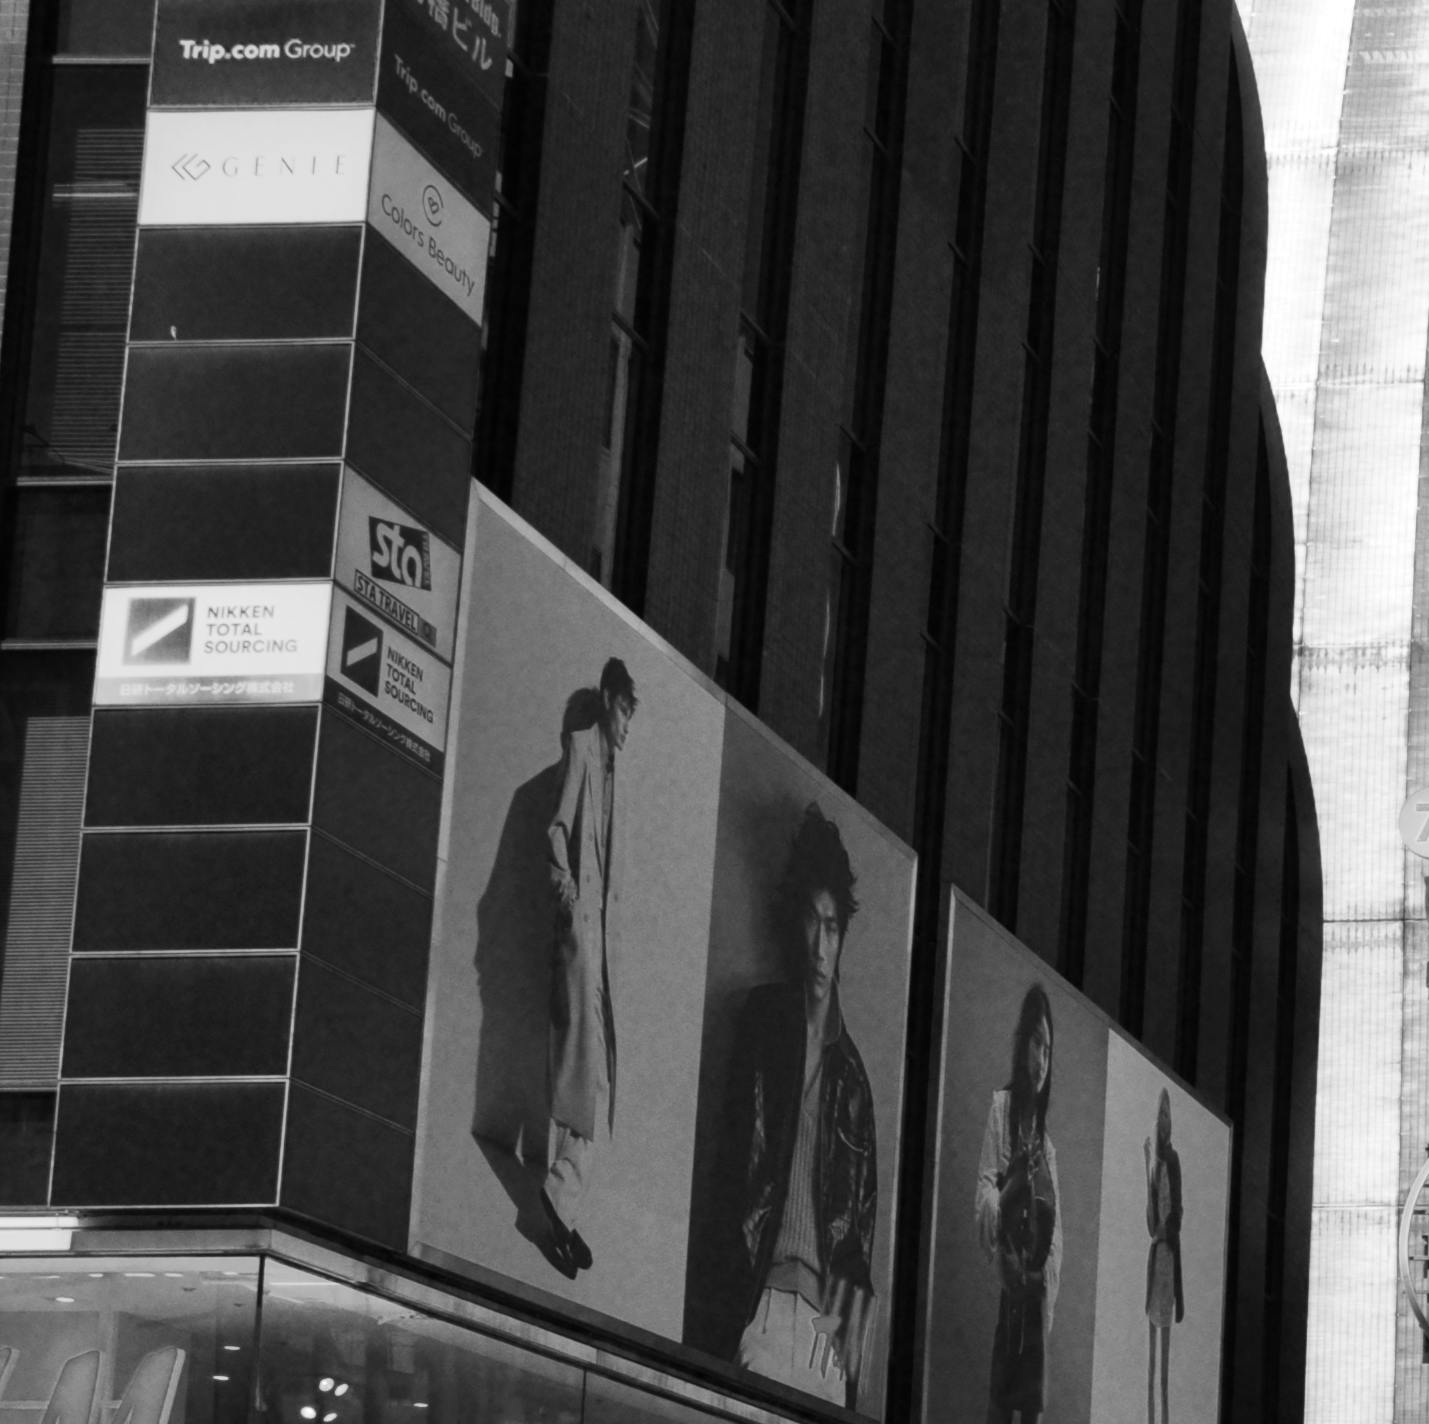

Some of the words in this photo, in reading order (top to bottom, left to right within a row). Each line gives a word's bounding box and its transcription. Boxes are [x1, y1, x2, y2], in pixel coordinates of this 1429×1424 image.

[179, 39, 280, 64] Trip.com
[284, 38, 351, 62] Group
[448, 112, 482, 158] Group
[222, 155, 346, 177] GENIE
[381, 193, 424, 248] Colors
[428, 235, 475, 296] Beauty
[207, 605, 275, 619] NIKKEN
[356, 574, 377, 603] STA
[378, 590, 418, 632] TRAVEL
[206, 623, 263, 637] TOTAL
[204, 639, 298, 655] SOURCING
[386, 662, 416, 695] TOTAL
[387, 646, 424, 682] NIKKEN
[384, 680, 434, 724] SOURCING
